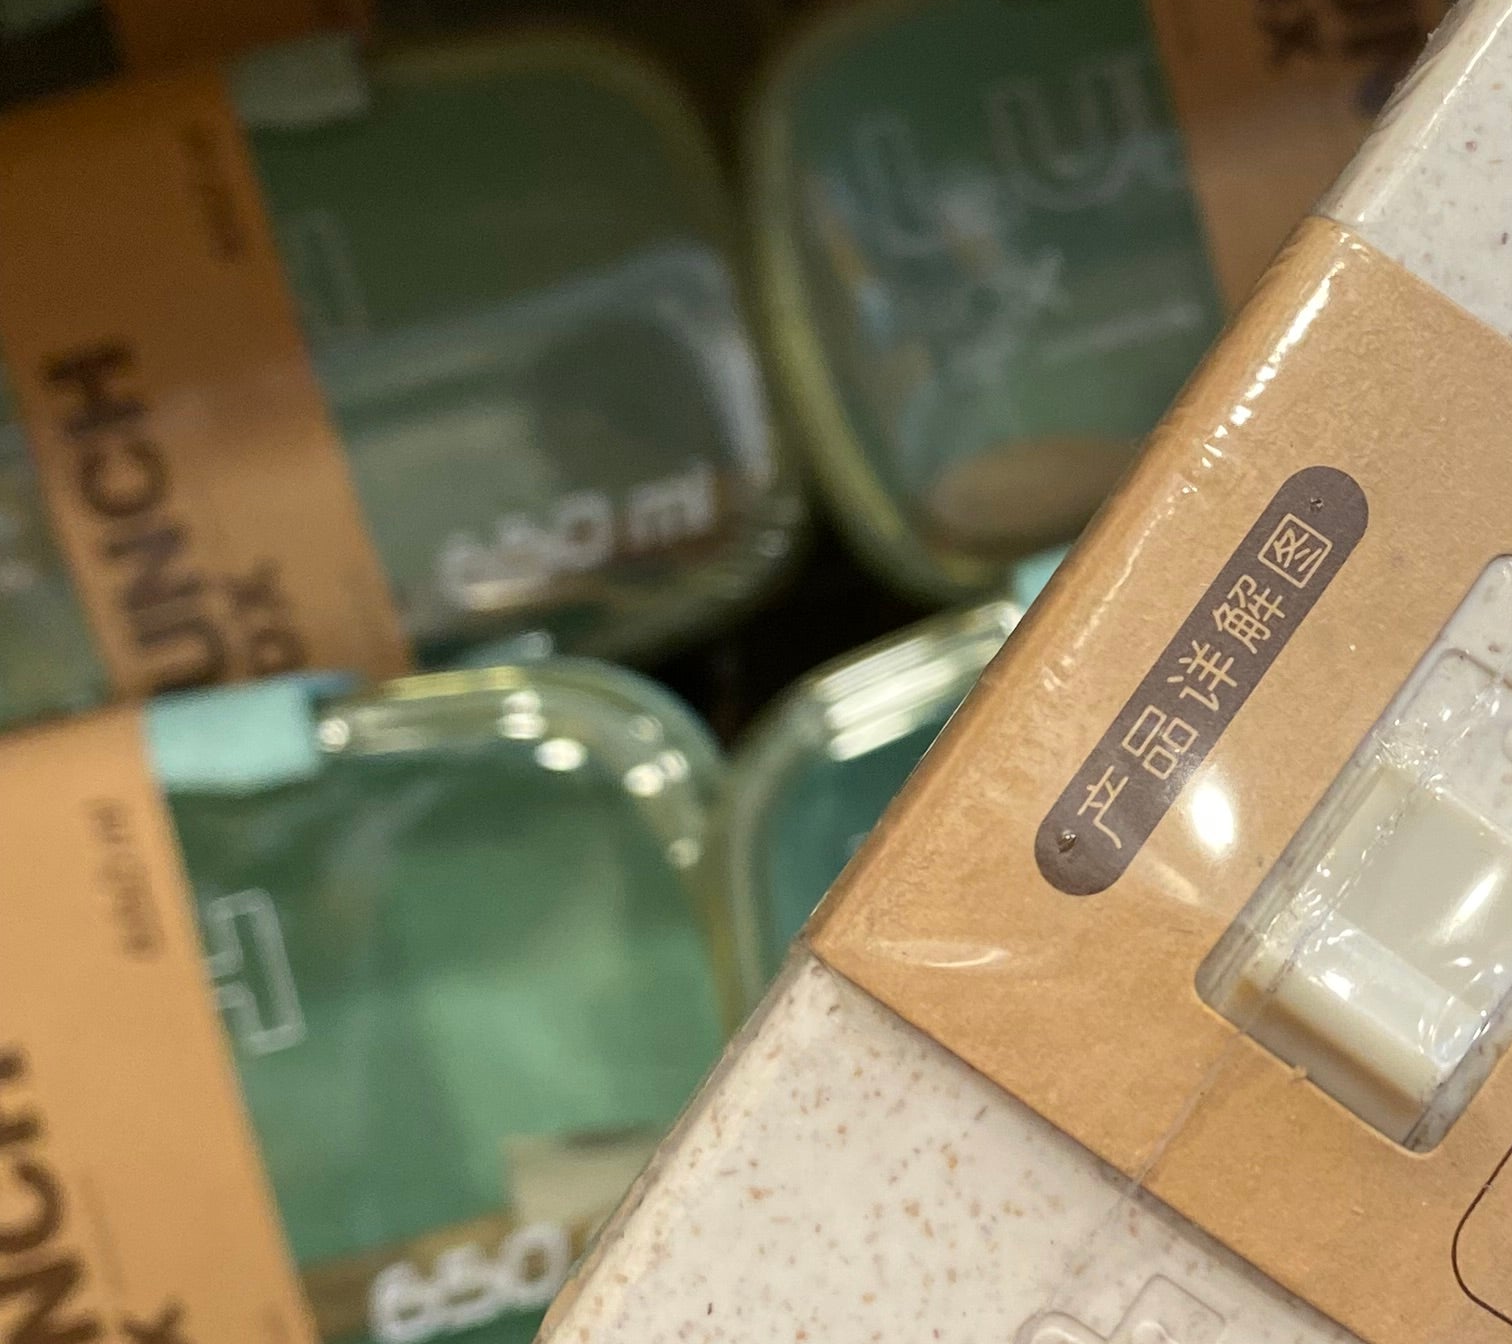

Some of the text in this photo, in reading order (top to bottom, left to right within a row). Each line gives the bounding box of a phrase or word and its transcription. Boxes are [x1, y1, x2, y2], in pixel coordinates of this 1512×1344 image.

[41, 337, 227, 697] UNCH
[228, 562, 306, 675] OX
[1077, 513, 1332, 849] 产品详解图
